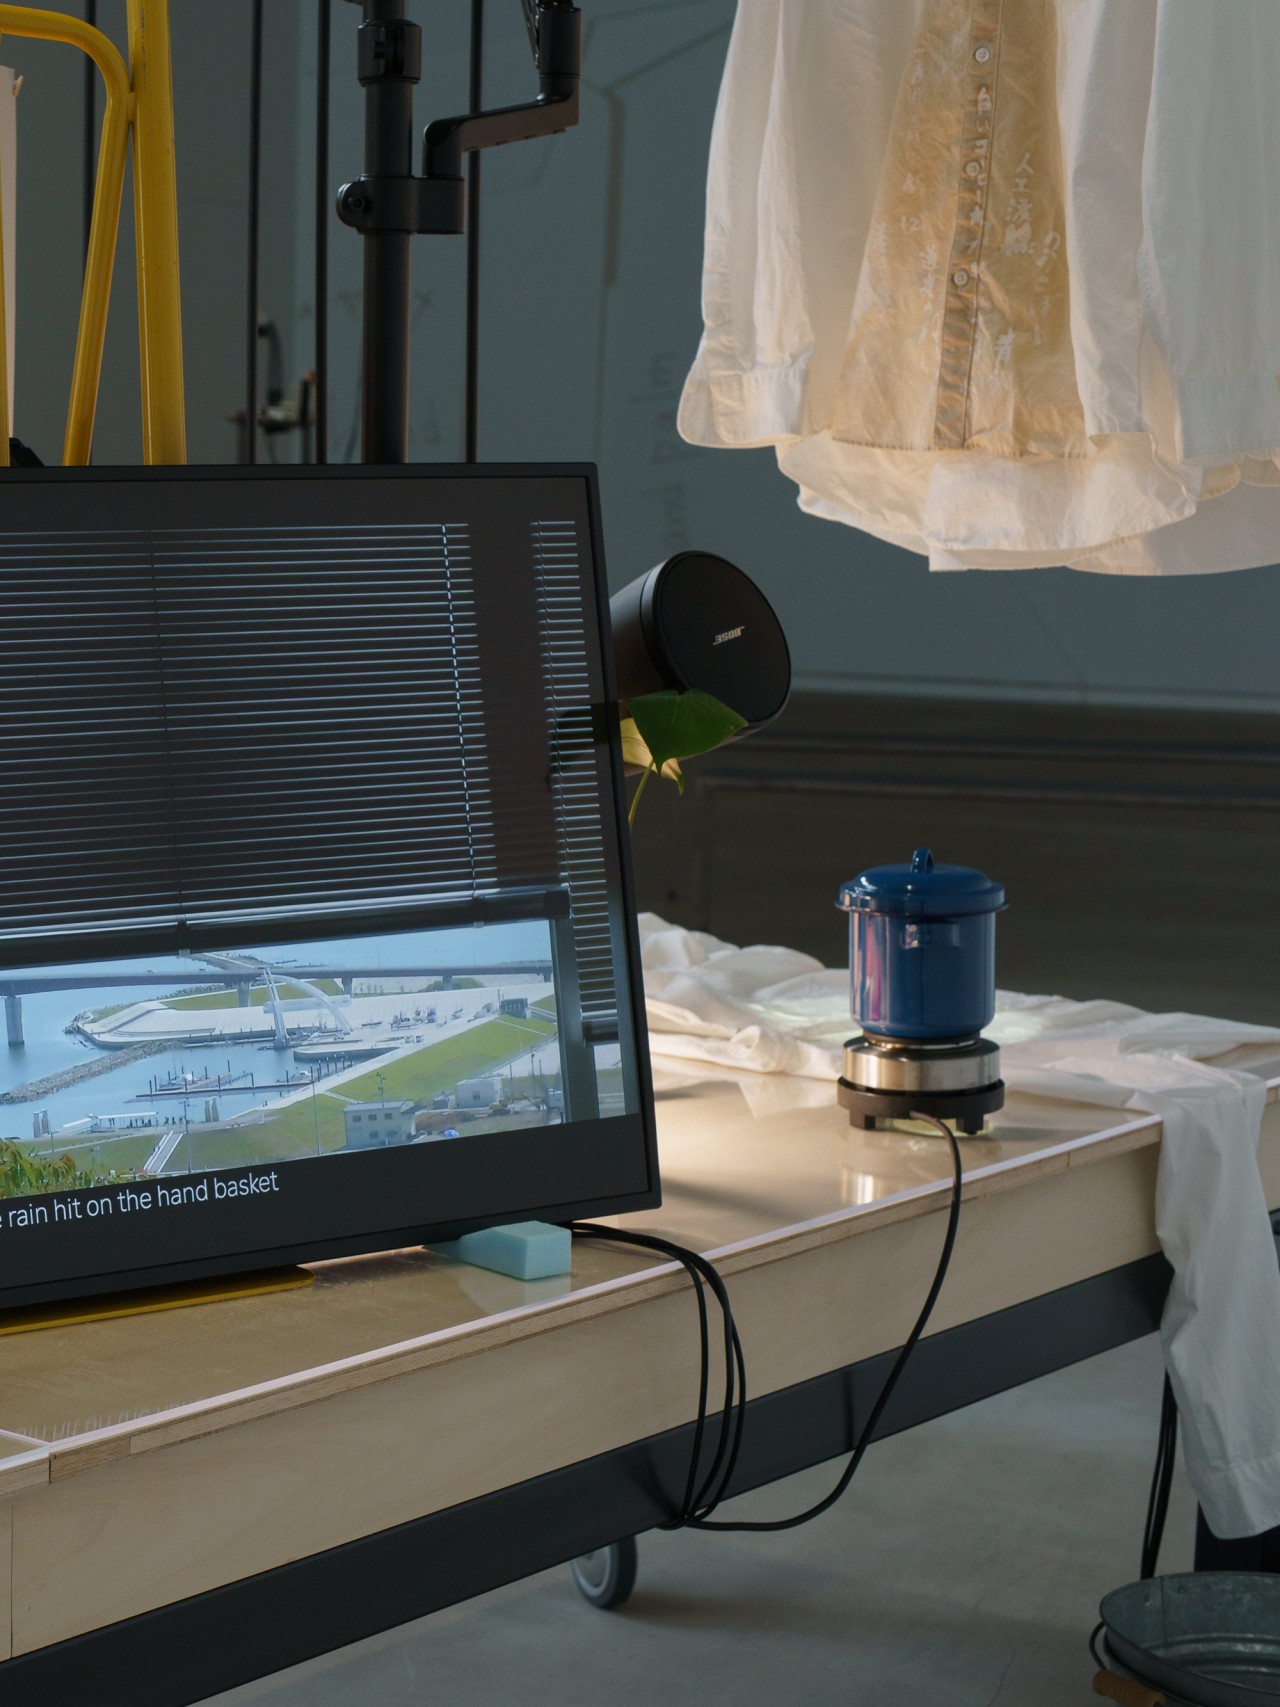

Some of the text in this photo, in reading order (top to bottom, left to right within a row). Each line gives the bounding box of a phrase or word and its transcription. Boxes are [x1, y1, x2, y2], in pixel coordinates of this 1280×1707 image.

[713, 626, 745, 646] BOSE
[9, 1203, 48, 1228] rain
[54, 1198, 82, 1221] hit
[86, 1196, 112, 1217] on
[117, 1190, 152, 1212] the
[157, 1179, 209, 1207] hand
[214, 1171, 280, 1199] basket
